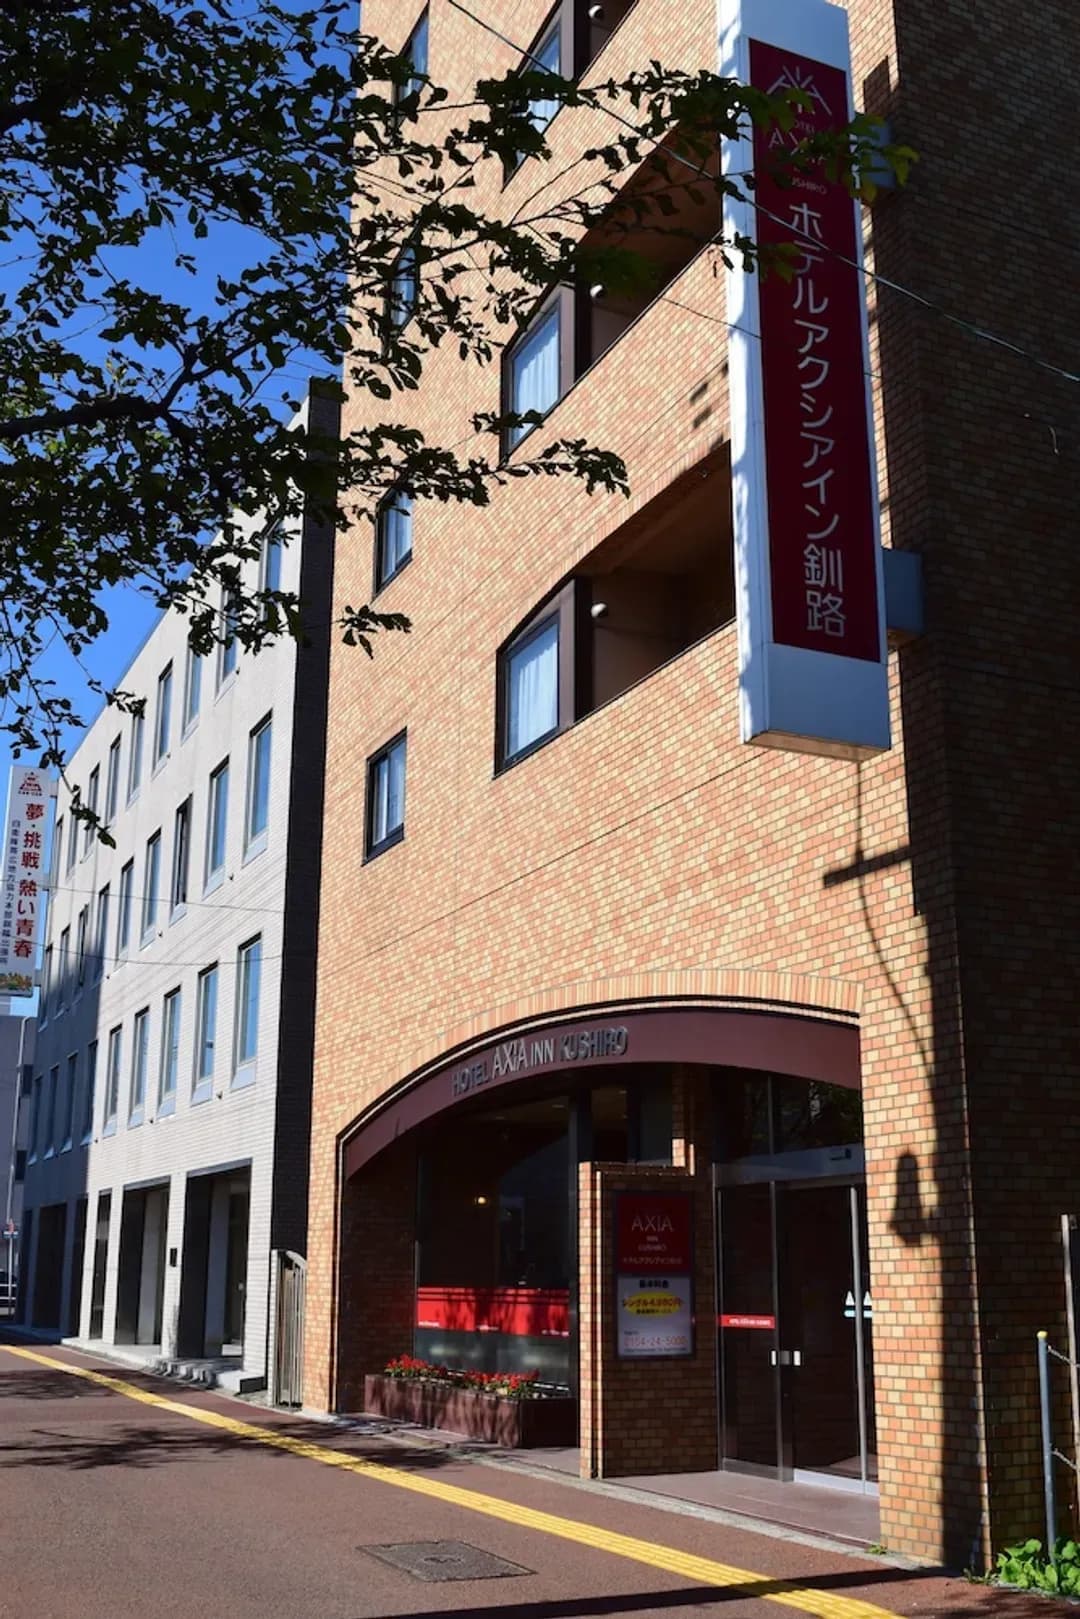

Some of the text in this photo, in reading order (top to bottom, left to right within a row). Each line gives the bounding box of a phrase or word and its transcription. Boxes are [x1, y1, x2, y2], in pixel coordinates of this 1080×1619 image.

[789, 202, 847, 638] ホテルアクシアイン釧路
[13, 803, 44, 959] 夢・挑戦・熱い青春
[453, 1026, 629, 1096] HOTEL AXIA INN KUSHIRO
[631, 1215, 673, 1232] AXIA
